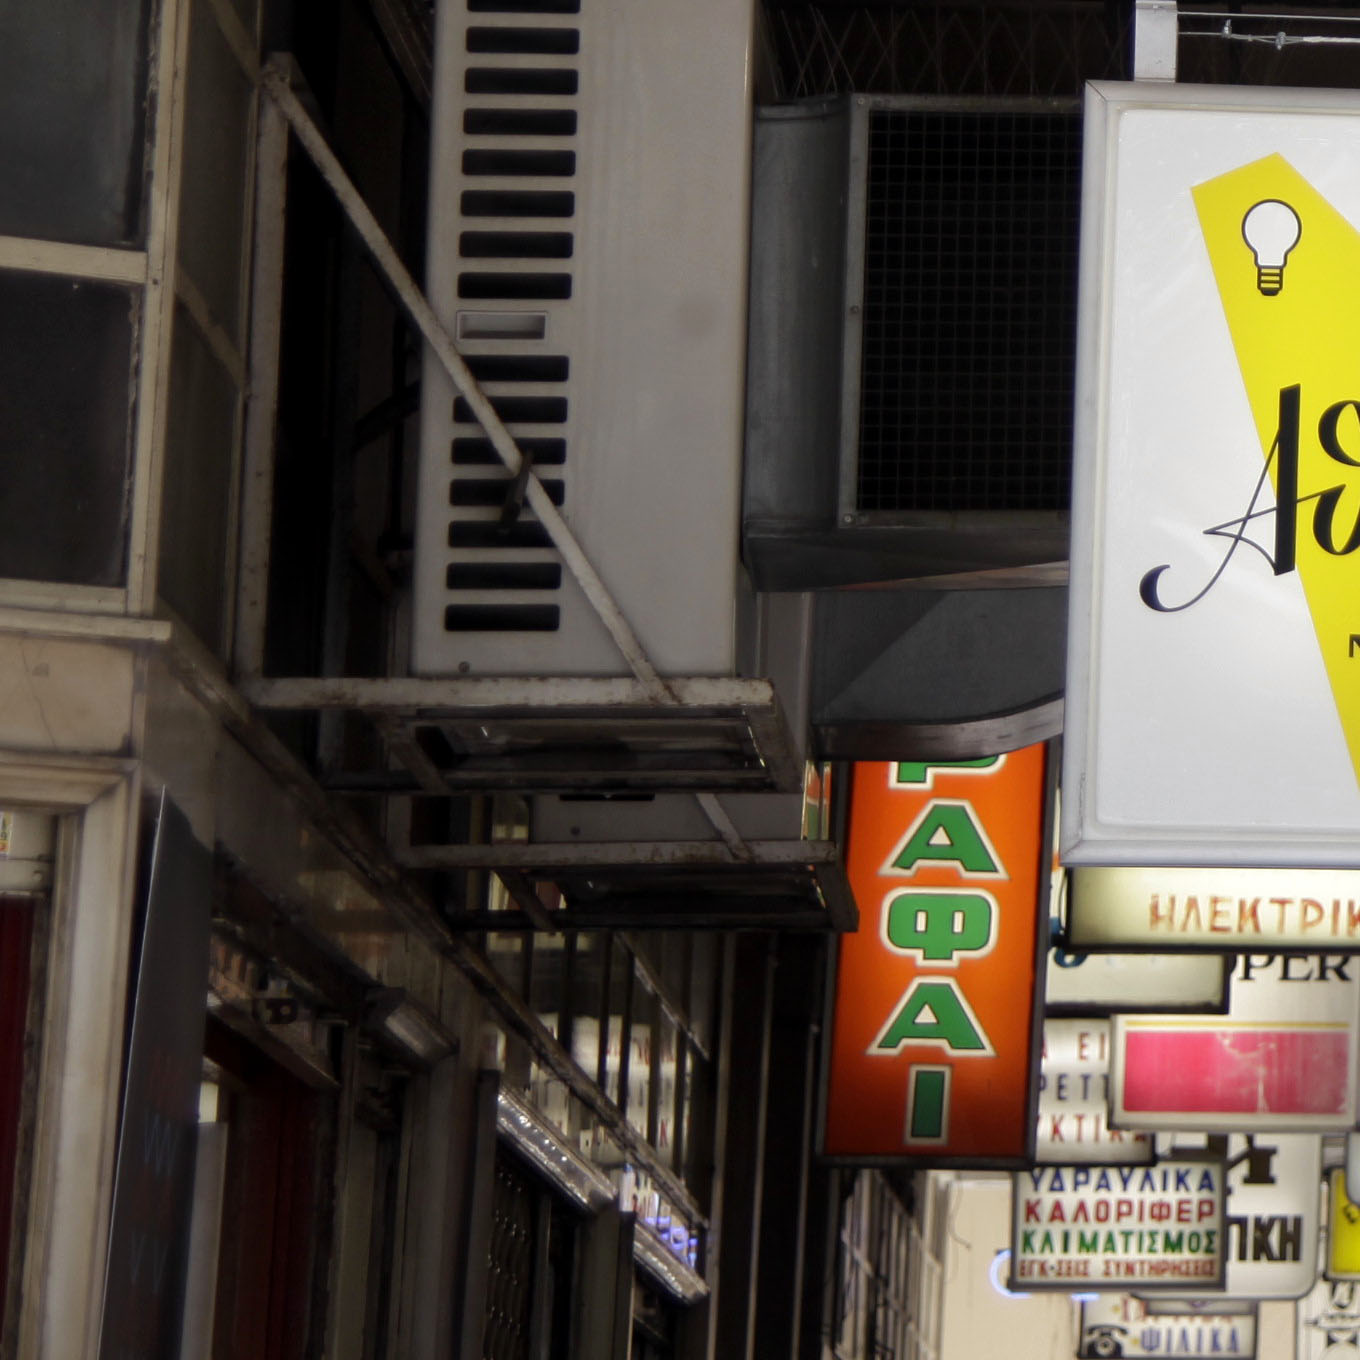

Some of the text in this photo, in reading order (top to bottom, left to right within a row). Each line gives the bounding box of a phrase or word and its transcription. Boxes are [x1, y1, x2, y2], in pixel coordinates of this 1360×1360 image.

[1029, 1168, 1216, 1193] ΥΔΡΑΥΛΙΚΑ
[1024, 1198, 1216, 1224] ΚΑΛΟΡΙΦΕΡ
[1021, 1230, 1217, 1255] ΚΛΙΜΑΤΙΣΜΟΣ
